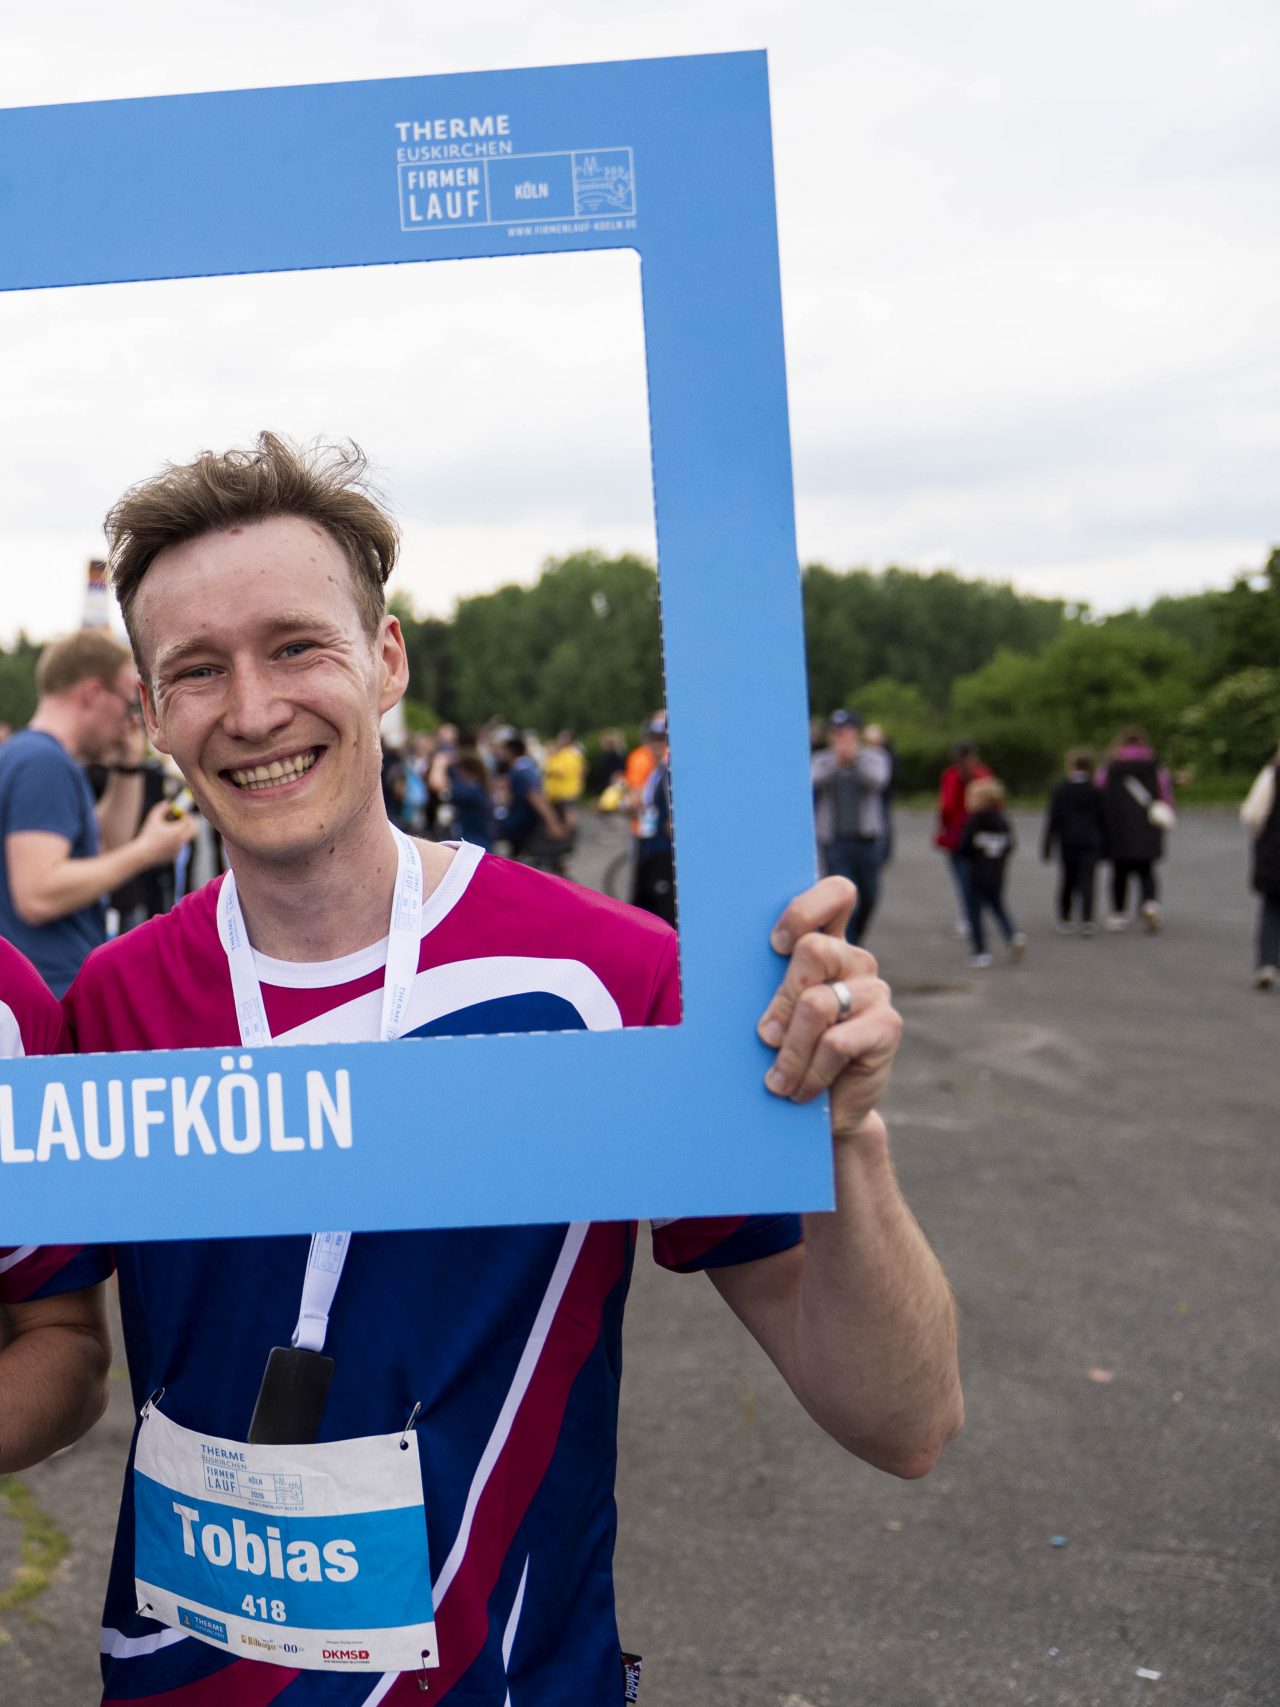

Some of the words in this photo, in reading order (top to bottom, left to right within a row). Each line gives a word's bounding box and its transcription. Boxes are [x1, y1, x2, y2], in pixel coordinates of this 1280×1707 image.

[395, 115, 510, 142] THERME
[396, 141, 512, 162] EUSKIRCHEN
[408, 167, 479, 190] FIRMEN
[515, 182, 549, 200] KÖLN
[409, 189, 480, 221] LAUF
[200, 1444, 246, 1462] THERME
[206, 1466, 235, 1481] FIRMEN
[248, 1475, 263, 1485] KÖLN
[207, 1476, 237, 1493] LAUF
[172, 1501, 360, 1584] Tobias
[241, 1594, 288, 1623] 418
[194, 1616, 225, 1633] THERME
[322, 1649, 359, 1660] DKMS
